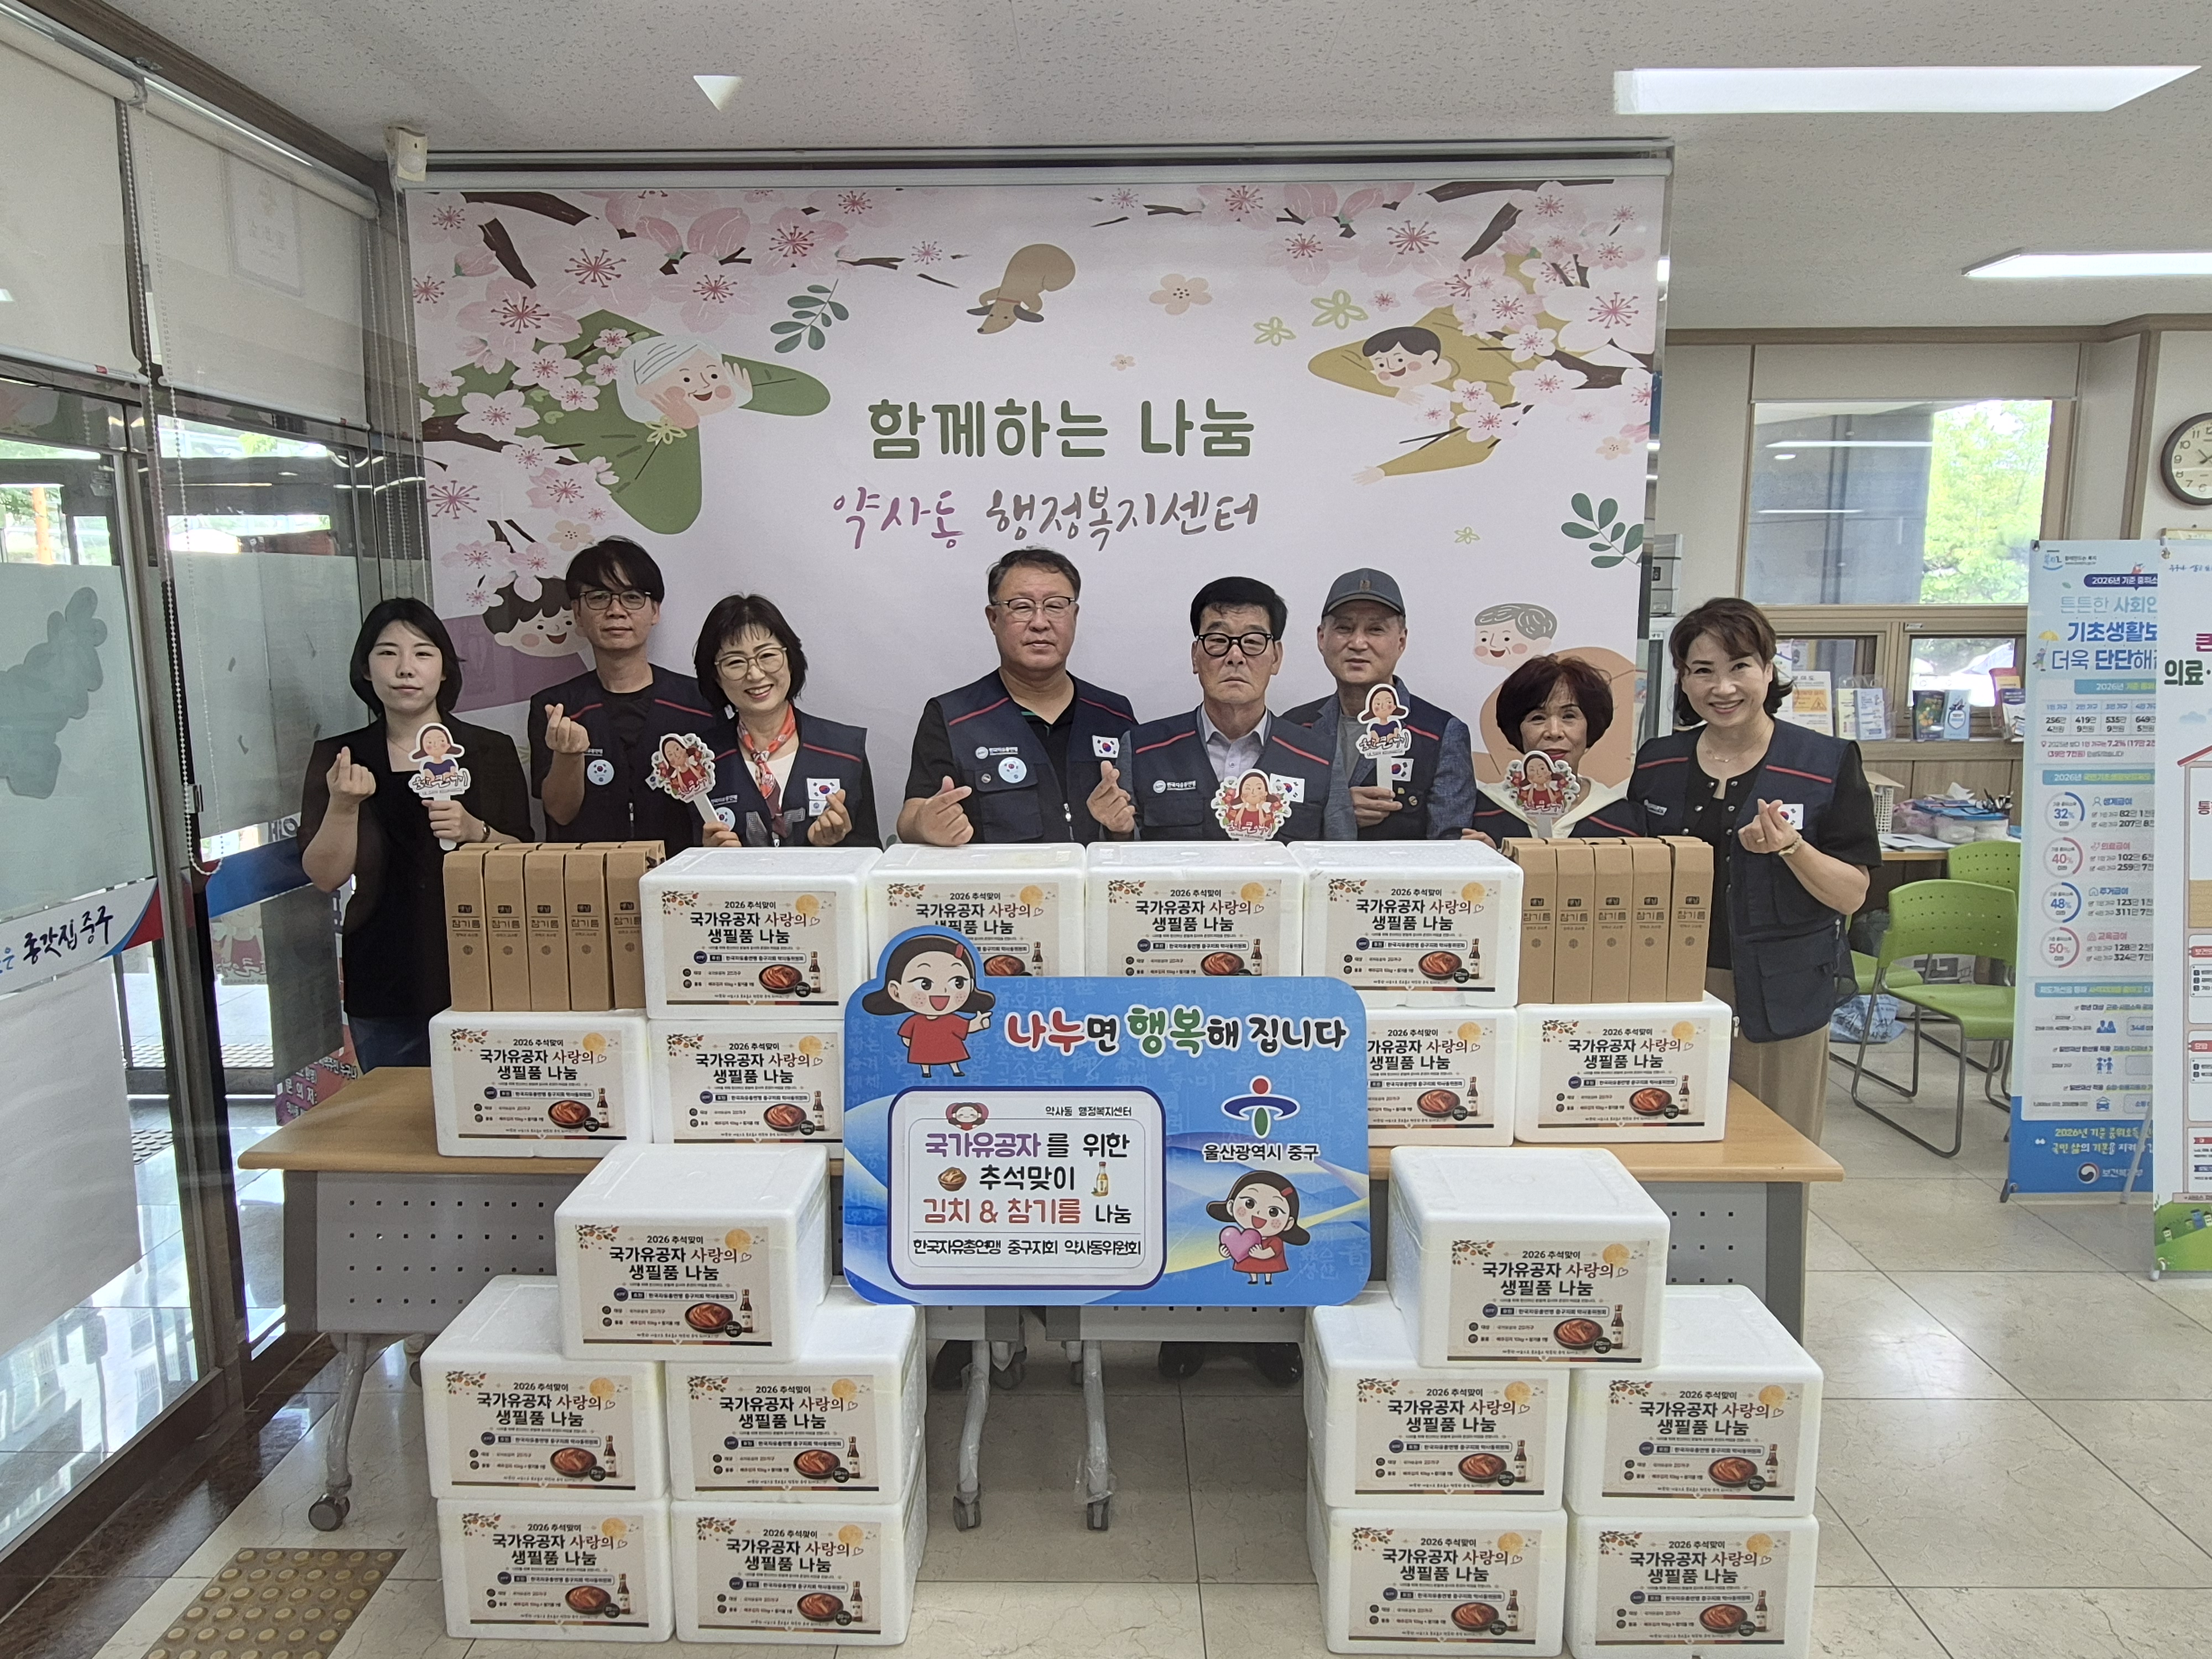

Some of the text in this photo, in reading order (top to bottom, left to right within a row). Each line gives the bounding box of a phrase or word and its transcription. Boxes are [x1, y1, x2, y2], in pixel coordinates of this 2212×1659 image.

[869, 399, 1254, 459] 함께하는 나눔
[2174, 455, 2182, 463] 9
[834, 486, 1258, 551] 약사동 행정복지센터
[2060, 597, 2109, 613] 튼튼한
[2052, 649, 2157, 670] 더욱 단단해
[916, 903, 1030, 918] 국가유공자 사랑의
[1135, 900, 1251, 915] 국가유공자 사랑의
[1356, 899, 1471, 915] 국가유공자 사랑의
[690, 912, 806, 927] 국가유공자 사랑의
[984, 920, 1014, 935] 나눔
[1152, 917, 1234, 932] 생필품 나눔
[1372, 916, 1453, 931] 생필품 나눔
[23, 905, 113, 965] 종갓집 중구
[708, 929, 790, 943] 생필품 나눔
[1008, 1007, 1347, 1055] 나누면 행복해 집니다
[1368, 1040, 1467, 1054] 가유공자 사랑의
[1568, 1039, 1681, 1052] 국가유공자 사랑의
[480, 1050, 593, 1064] 국가유공자 사랑의
[695, 1053, 810, 1067] 국가유공자 사랑의
[1370, 1055, 1450, 1071] 생필품 나눔
[1584, 1055, 1663, 1069] 생필품 나눔
[498, 1066, 578, 1079] 생필품 나눔
[713, 1070, 794, 1083] 생필품 나눔
[1045, 1106, 1131, 1117] 약사동 행정복지센터
[925, 1133, 1130, 1158] 국가유공자 를 위한
[1204, 1144, 1318, 1160] 울산광역시 중구
[979, 1165, 1074, 1190] 추석맞이
[923, 1198, 1131, 1224] 김치 & 참기름 나눔
[647, 1235, 703, 1244] 2026 추석맞이
[914, 1239, 1140, 1255] 한국자유총연맹 중구지회 약사동위원회
[609, 1247, 737, 1263] 국가유공자 사랑의
[1548, 1251, 1580, 1259] 추석맞이
[629, 1265, 719, 1280] 생필품 나눔
[1483, 1262, 1613, 1278] 국가유공자 사랑의
[1501, 1280, 1593, 1296] 생필품 나눔
[477, 1392, 601, 1410] 국가유공자 사랑의
[719, 1396, 843, 1412] 국가유공자 사랑의
[1388, 1400, 1516, 1415] 국가유공자 사랑의
[1640, 1401, 1769, 1418] 국가유공자 사랑의
[497, 1410, 583, 1427] 생필품 나눔
[739, 1414, 826, 1429] 생필품 나눔
[1406, 1417, 1496, 1432] 생필품 나눔
[1658, 1419, 1749, 1436] 생필품 나눔
[493, 1534, 613, 1550] 국가유공자 사랑의
[726, 1538, 849, 1557] 국가유공자 사랑의
[512, 1551, 597, 1566] 생필품 나눔
[745, 1556, 831, 1572] 생필품 나눔
[1383, 1549, 1508, 1566] 국가유공자 사랑의
[1630, 1551, 1757, 1567] 국가유공자 사랑의
[1400, 1566, 1489, 1582] 생필품 나눔
[1648, 1569, 1738, 1584] 생필품 나눔
